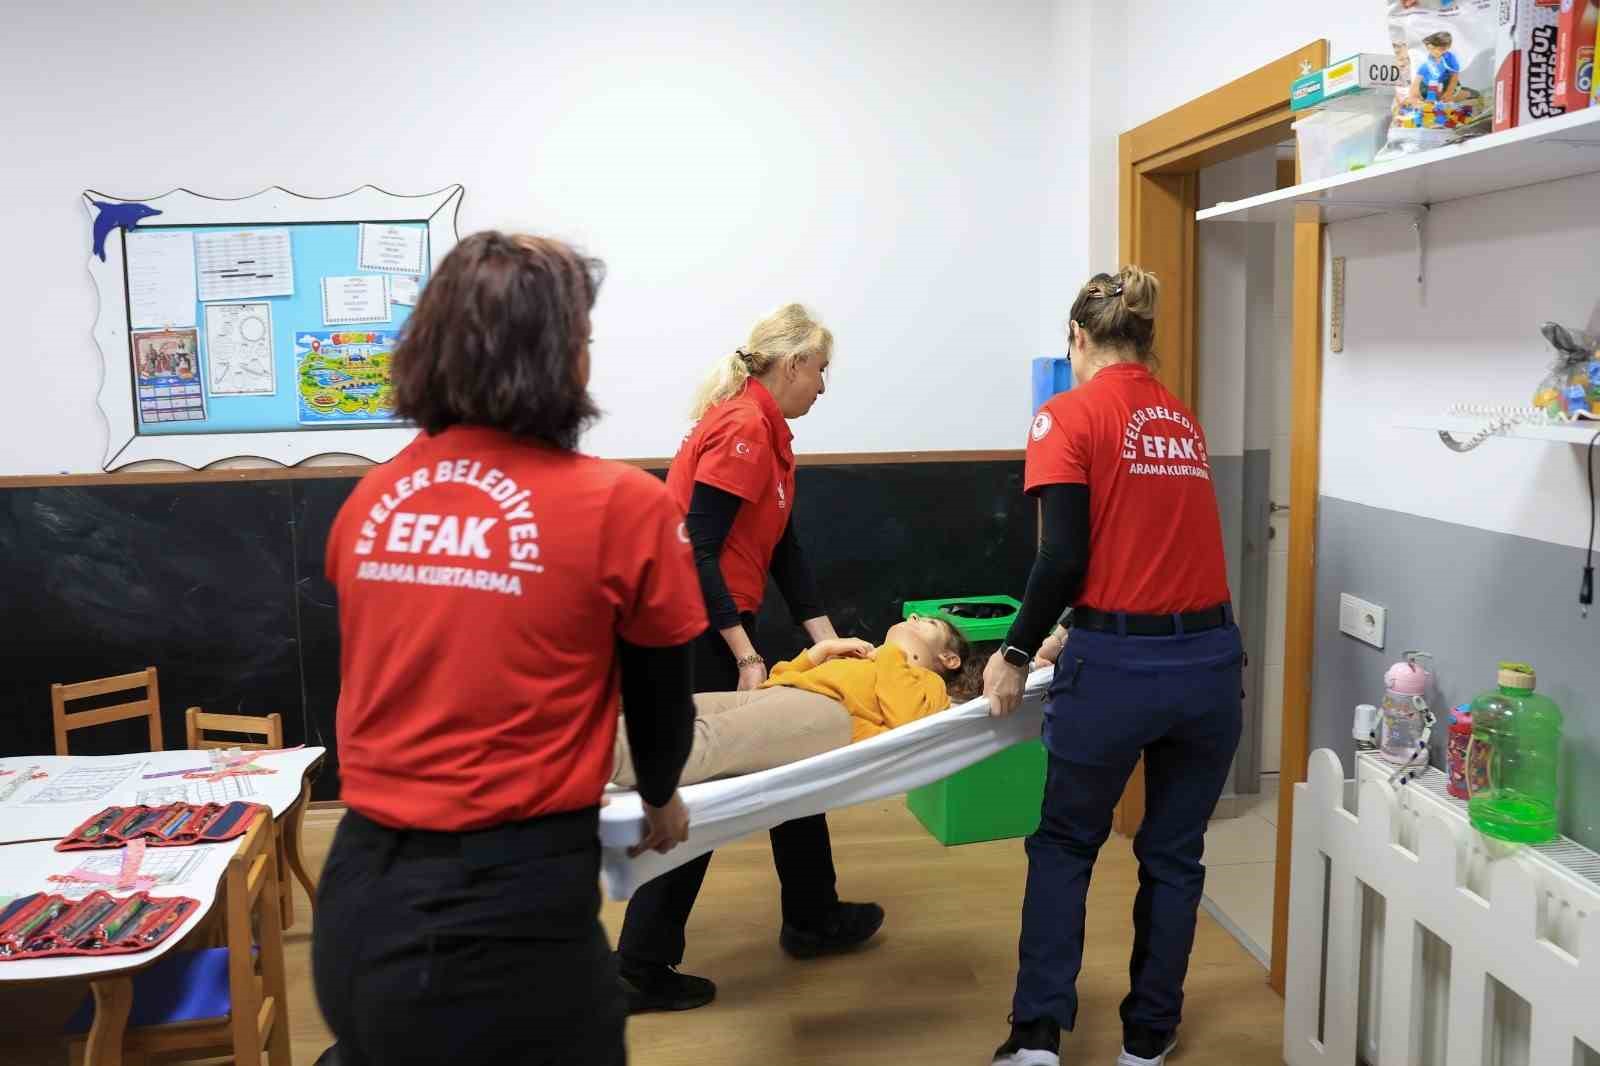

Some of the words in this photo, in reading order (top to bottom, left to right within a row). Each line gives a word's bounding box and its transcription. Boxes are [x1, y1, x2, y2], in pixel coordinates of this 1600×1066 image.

[1529, 25, 1553, 118] SKILLFUL
[1122, 408, 1150, 460] EFELER
[1142, 434, 1198, 460] EFAK
[1129, 463, 1167, 475] ARAMA
[354, 467, 433, 555] EFELER
[434, 459, 544, 574] BELEDİYESİ
[385, 512, 498, 559] EFAK
[357, 561, 415, 583] ARAMA
[416, 564, 523, 596] KURTARMA
